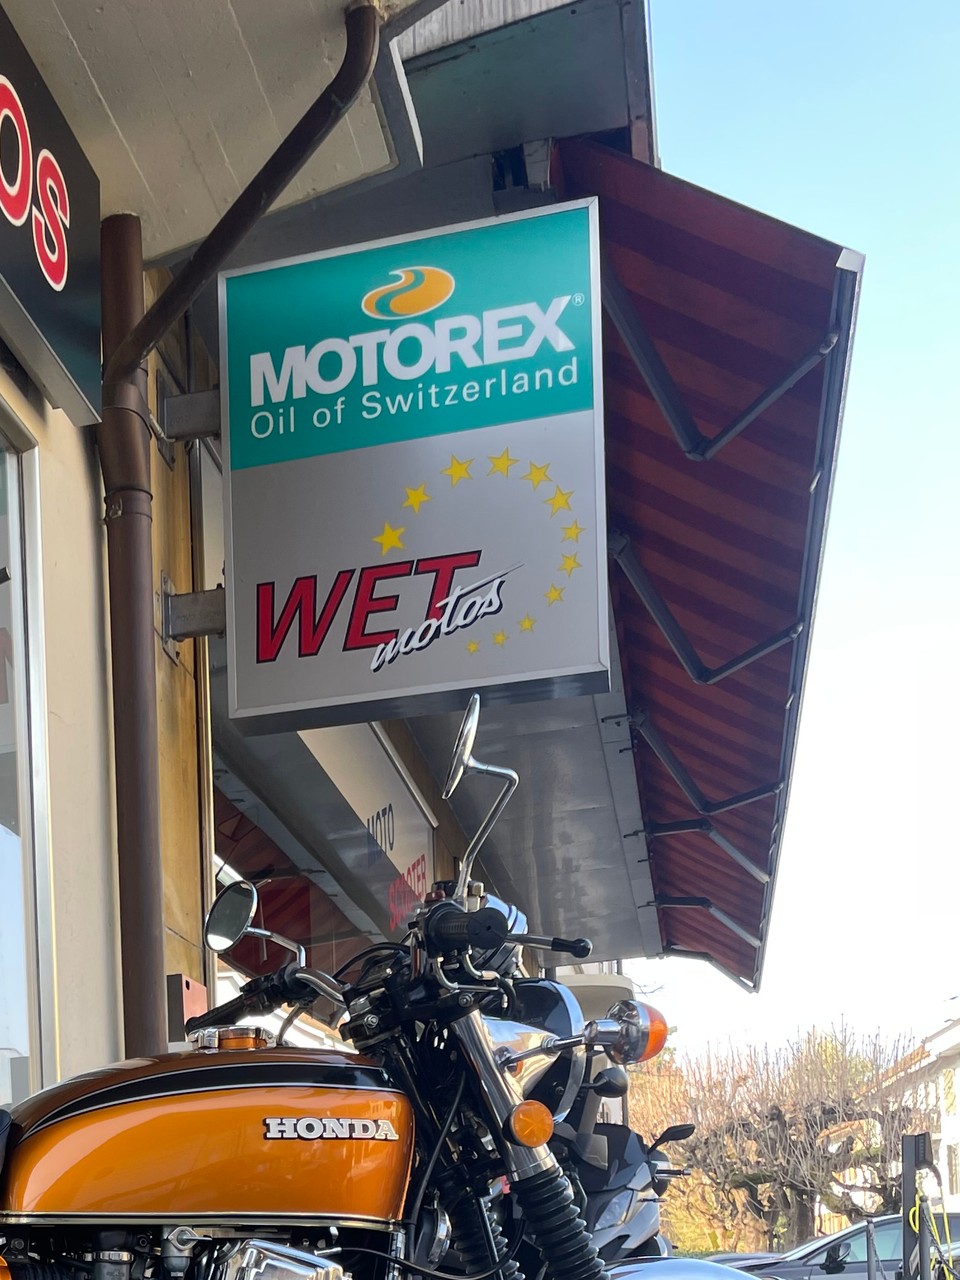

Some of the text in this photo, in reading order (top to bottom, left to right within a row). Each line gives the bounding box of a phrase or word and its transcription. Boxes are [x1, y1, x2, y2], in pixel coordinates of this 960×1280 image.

[251, 359, 579, 440] Oil of Switzerland
[255, 550, 482, 665] WET
[370, 561, 526, 673] motos
[387, 854, 428, 932] SCOOTER
[264, 1117, 399, 1141] HONDA
